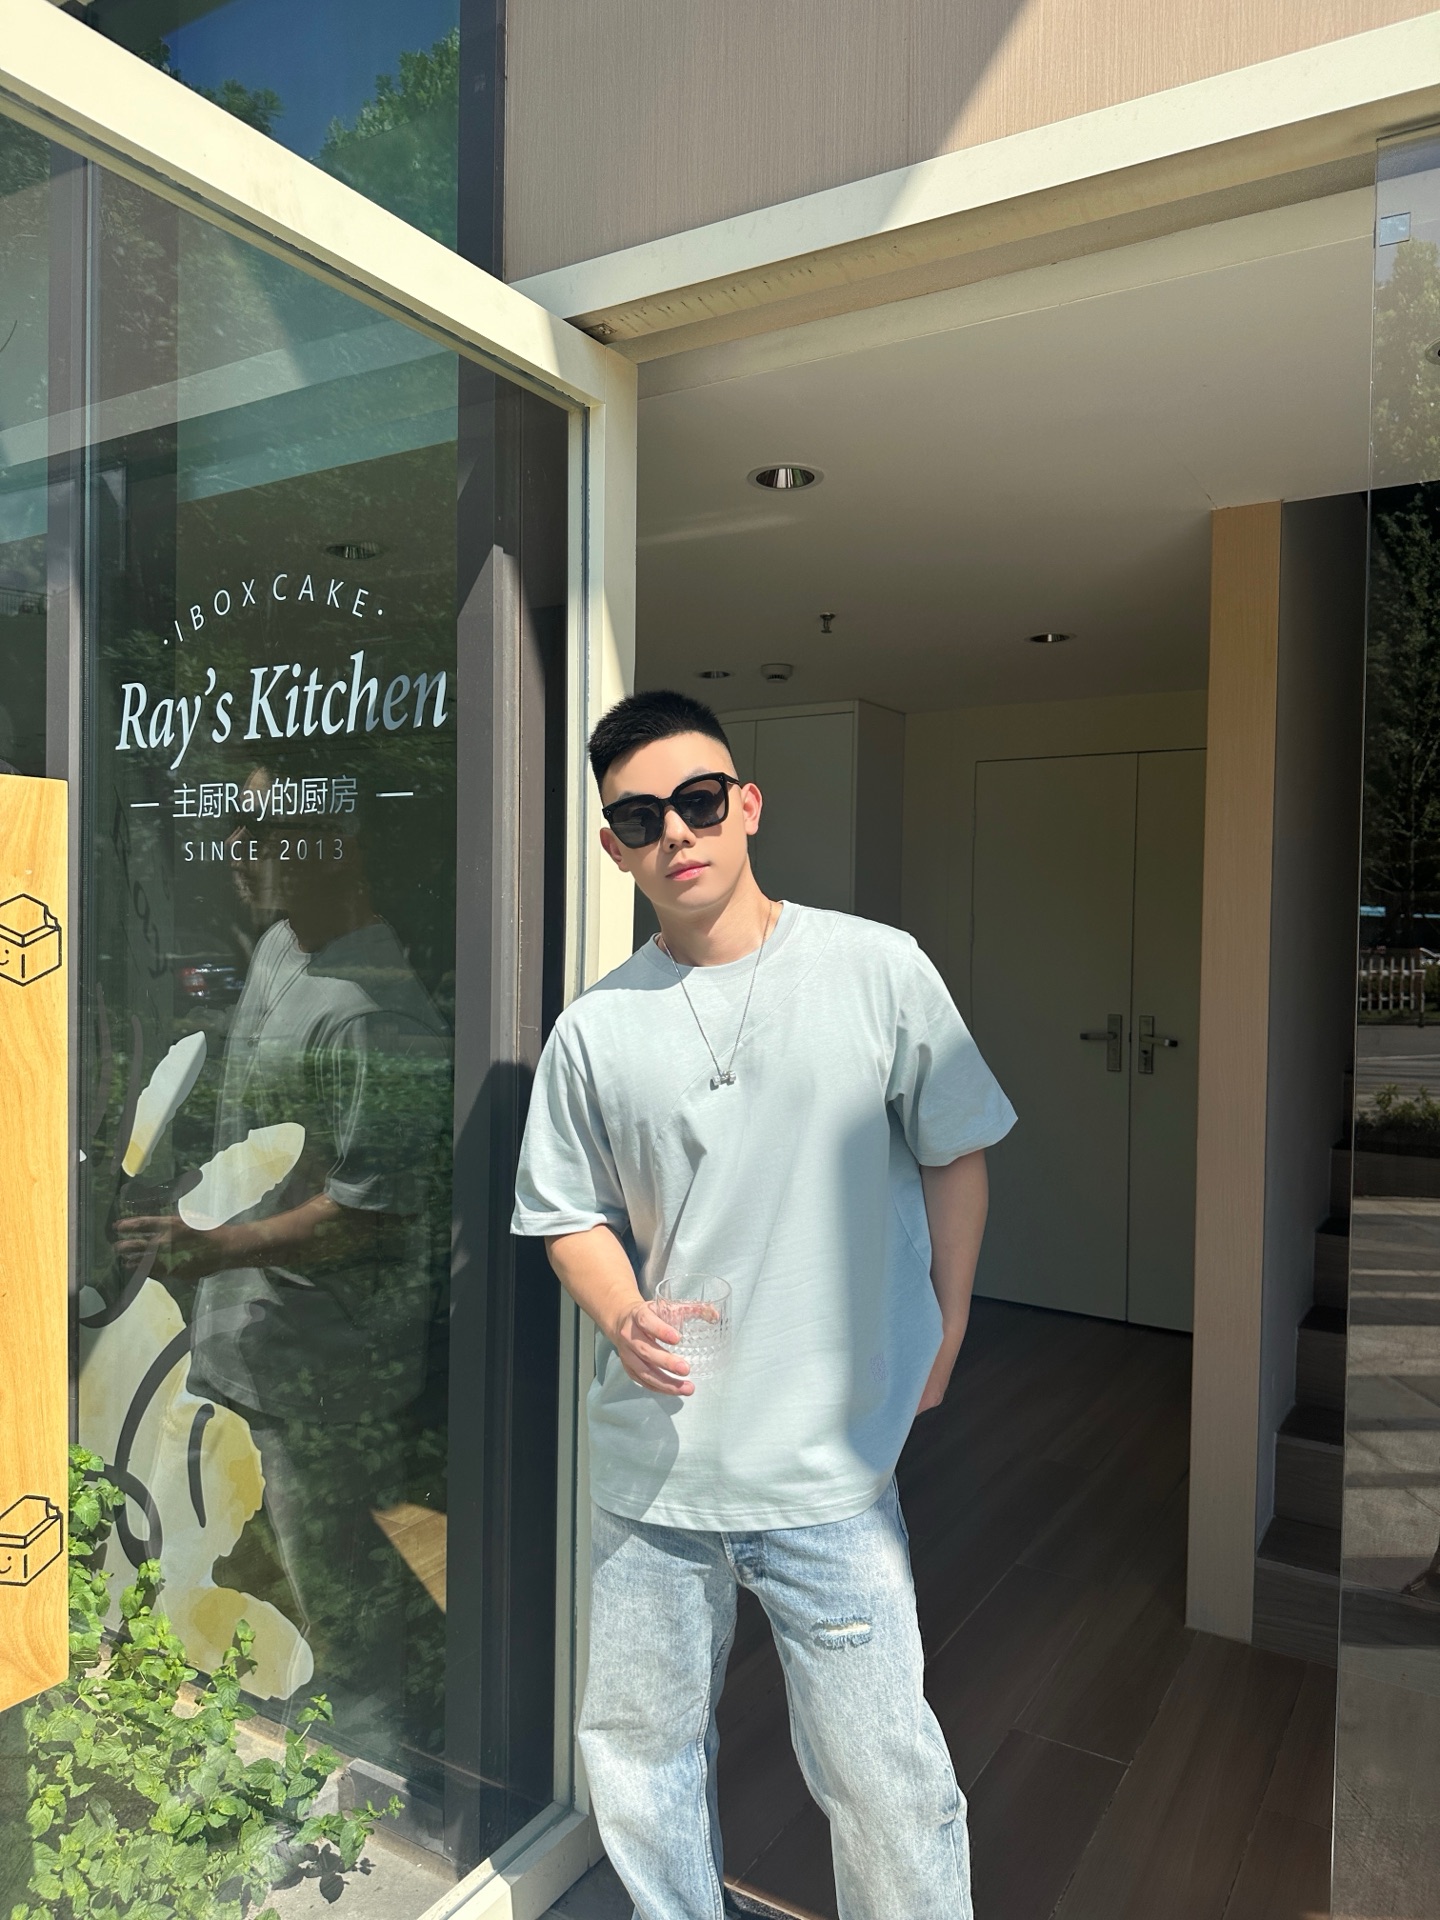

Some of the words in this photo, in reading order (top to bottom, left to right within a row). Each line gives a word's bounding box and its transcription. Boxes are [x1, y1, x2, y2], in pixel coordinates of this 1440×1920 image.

[115, 668, 234, 771] Ray's
[243, 650, 449, 740] Kitchen
[172, 775, 359, 821] 主厨Ray的厨房
[184, 841, 260, 861] SINCE
[280, 838, 344, 860] 2013
